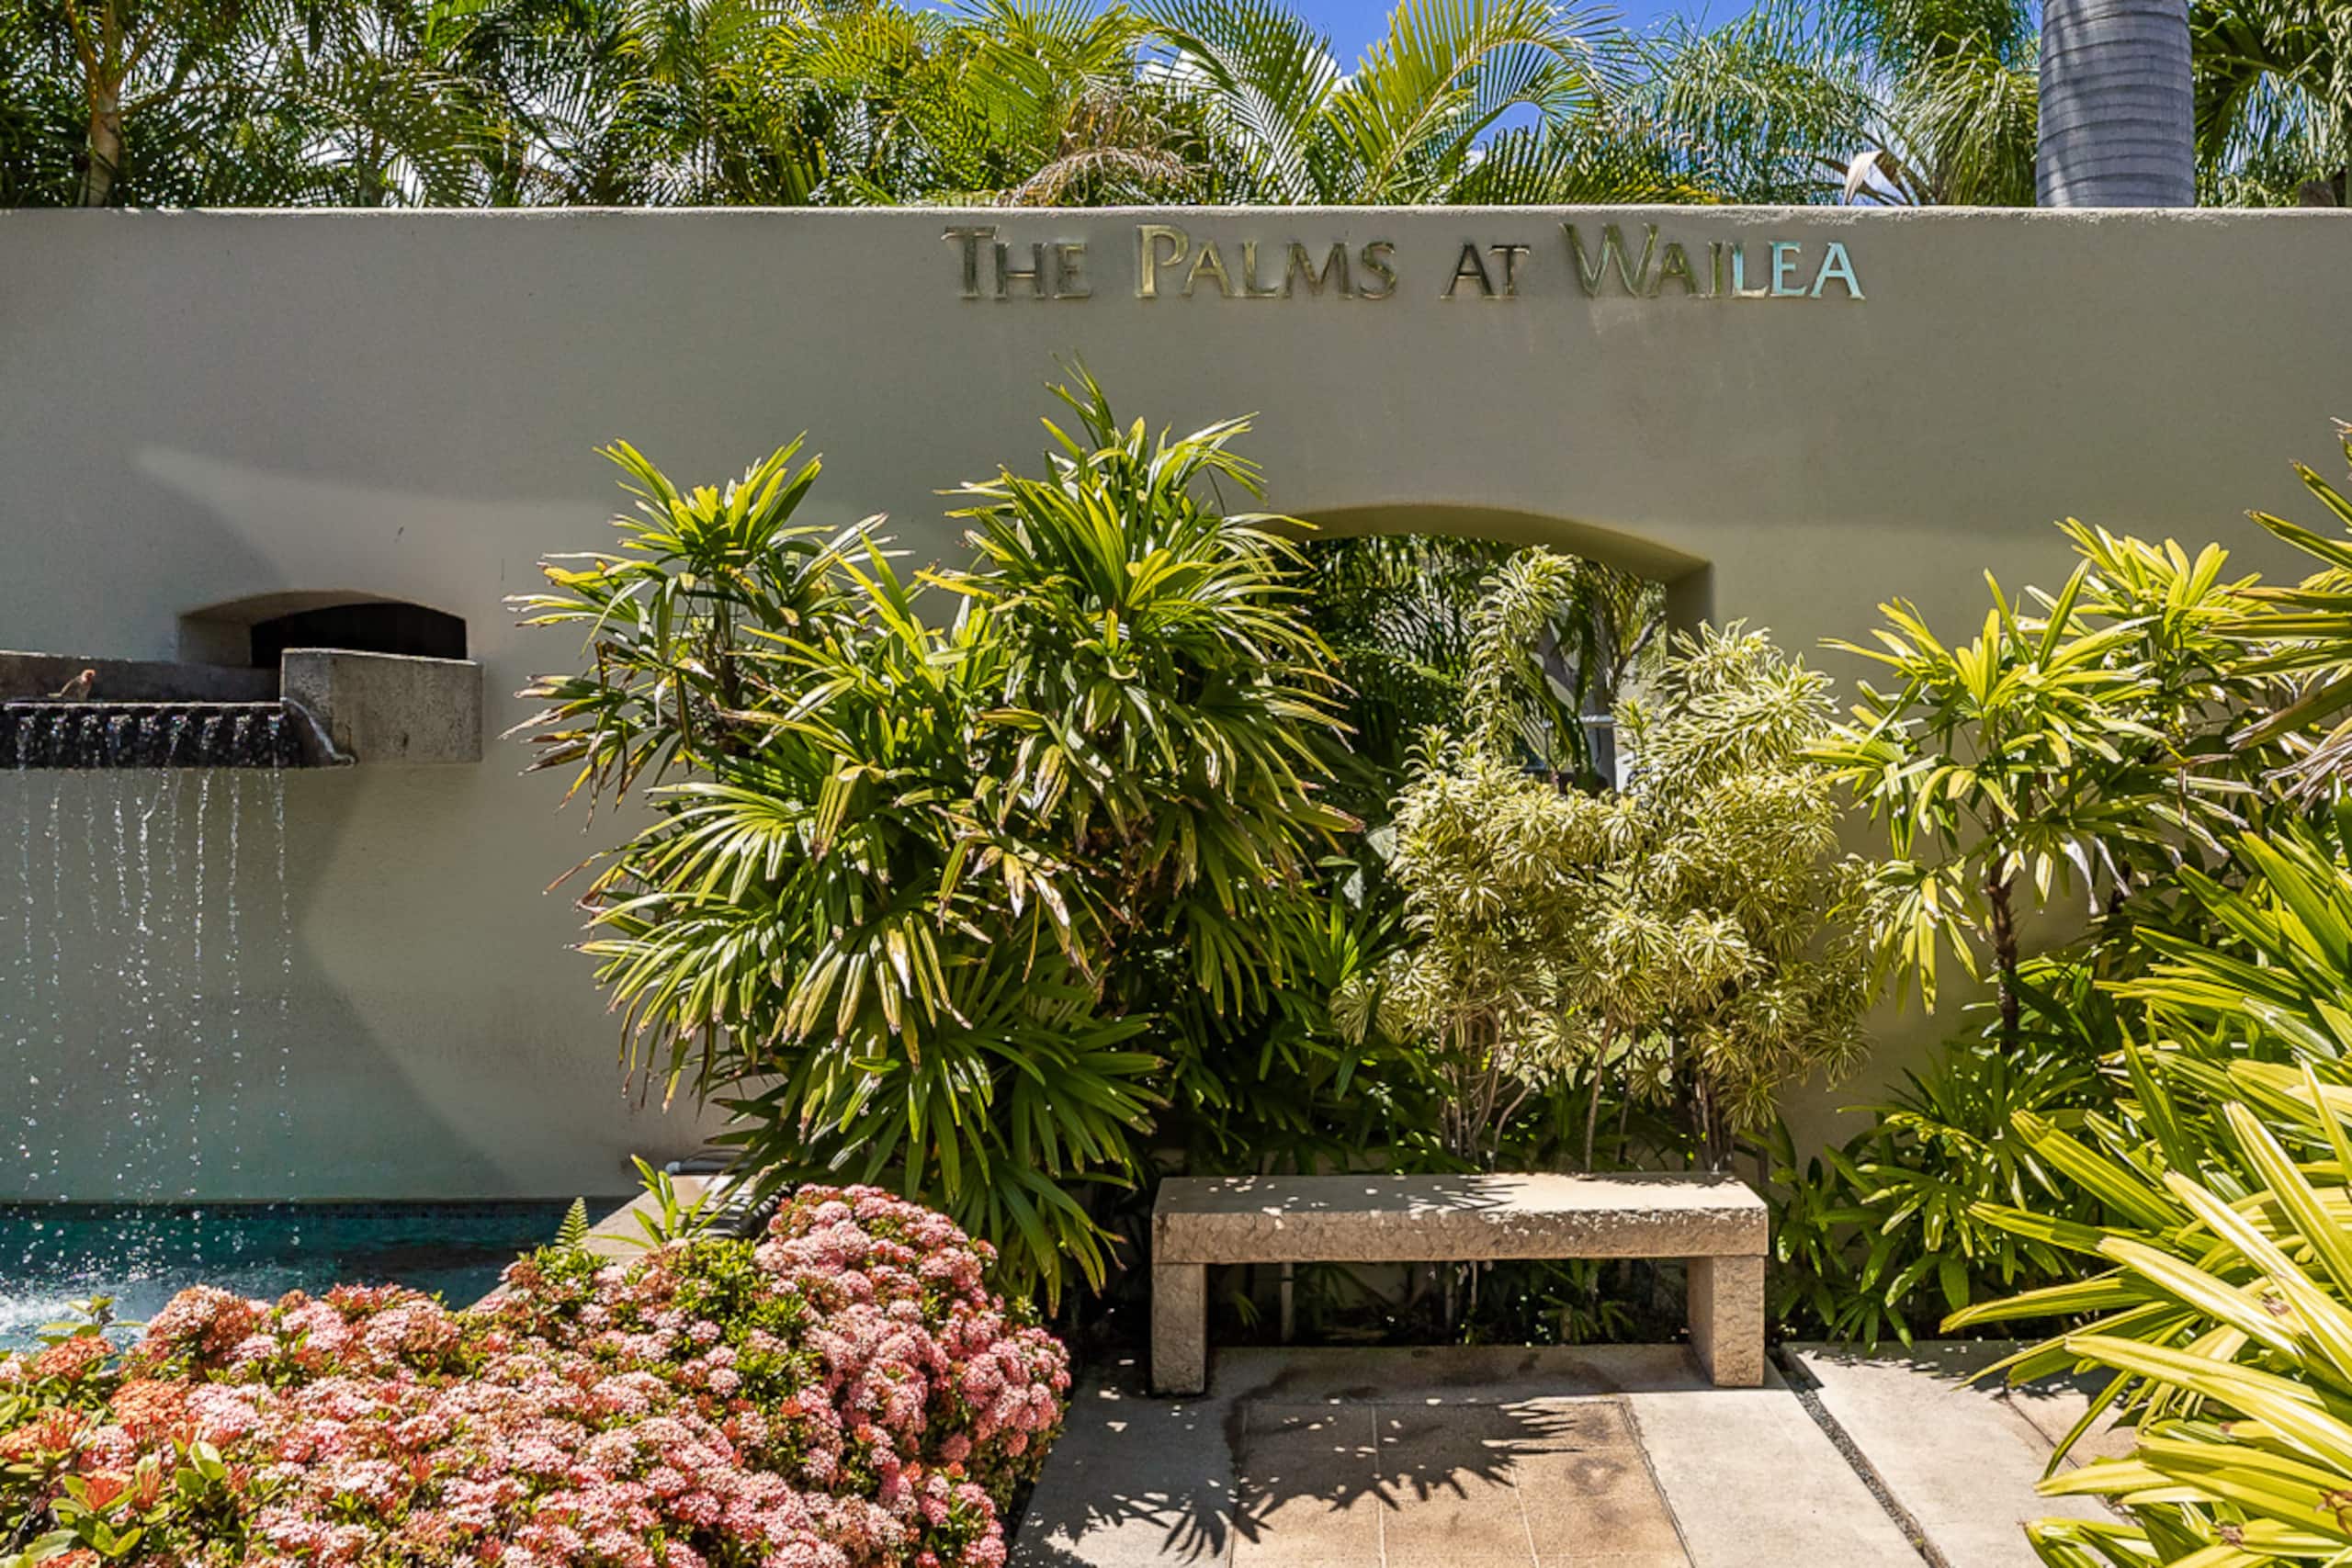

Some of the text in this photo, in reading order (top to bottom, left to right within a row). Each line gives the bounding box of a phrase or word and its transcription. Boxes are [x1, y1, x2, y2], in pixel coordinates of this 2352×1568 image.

[941, 222, 1866, 300] THE PALMS AT WAILEA
